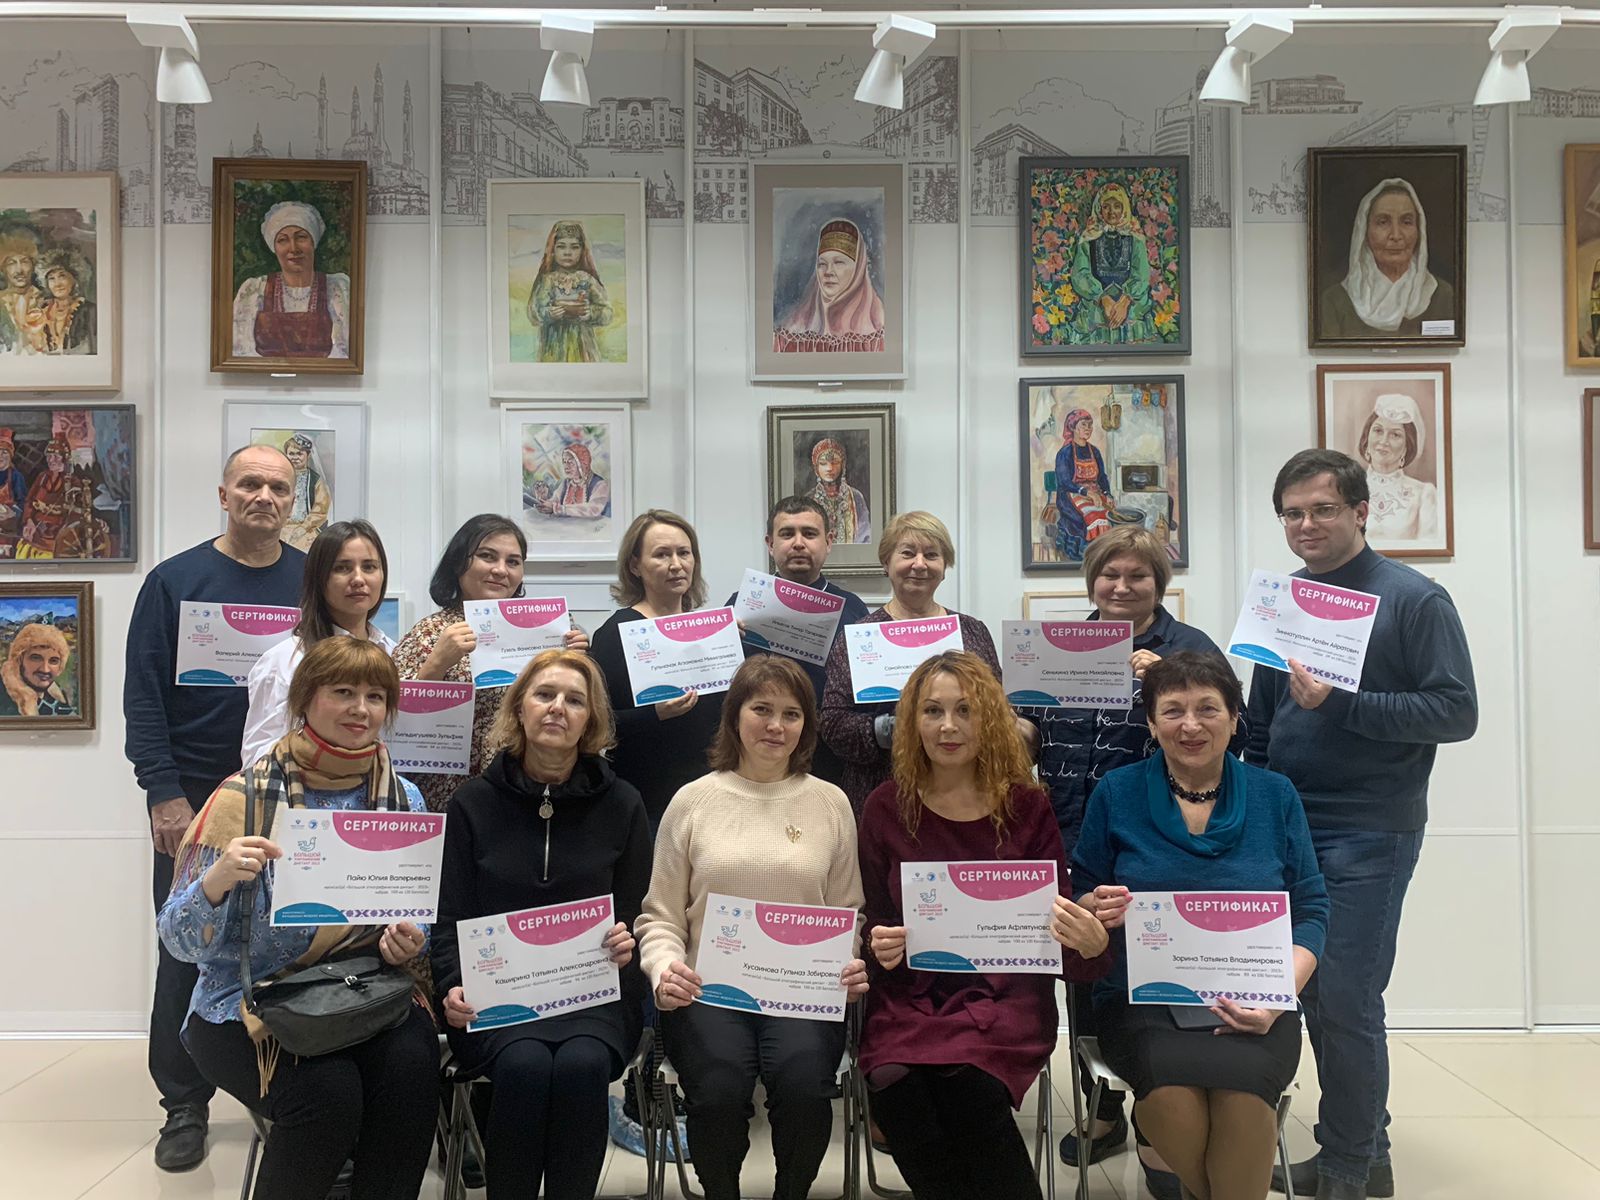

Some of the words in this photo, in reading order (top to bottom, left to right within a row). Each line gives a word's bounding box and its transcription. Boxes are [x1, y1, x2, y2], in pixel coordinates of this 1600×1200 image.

[780, 586, 838, 609] СЕРТИФИКАТ
[1298, 587, 1371, 612] СЕРТИФИКАТ
[506, 604, 562, 615] СЕРТИФИКАТ
[231, 611, 297, 623] СЕРТИФИКАТ
[664, 614, 728, 631] СЕРТИФИКАТ
[888, 622, 953, 636] СЕРТИФИКАТ
[1050, 628, 1125, 637] СЕРТИФИКАТ
[399, 688, 467, 699] ЕРТИФИКАТ
[343, 820, 436, 833] СЕРТИФИКАТ
[389, 874, 431, 882] Валерьевна
[959, 870, 1047, 882] СЕРТИФИКАТ
[1185, 901, 1279, 913] СЕРТИФИКАТ
[518, 905, 605, 931] СЕРТИФИКАТ
[764, 911, 848, 928] СЕРТИФИКАТ
[977, 924, 1007, 932] Гульфия
[1172, 955, 1199, 963] Зорина
[1200, 955, 1228, 963] Татьяна
[1229, 956, 1283, 965] Владимировна
[495, 974, 530, 985] Каширина
[531, 968, 558, 978] Татьяна
[559, 957, 609, 972] Александровна
[743, 962, 779, 974] Хусаинова
[780, 968, 805, 976] Гульназ
